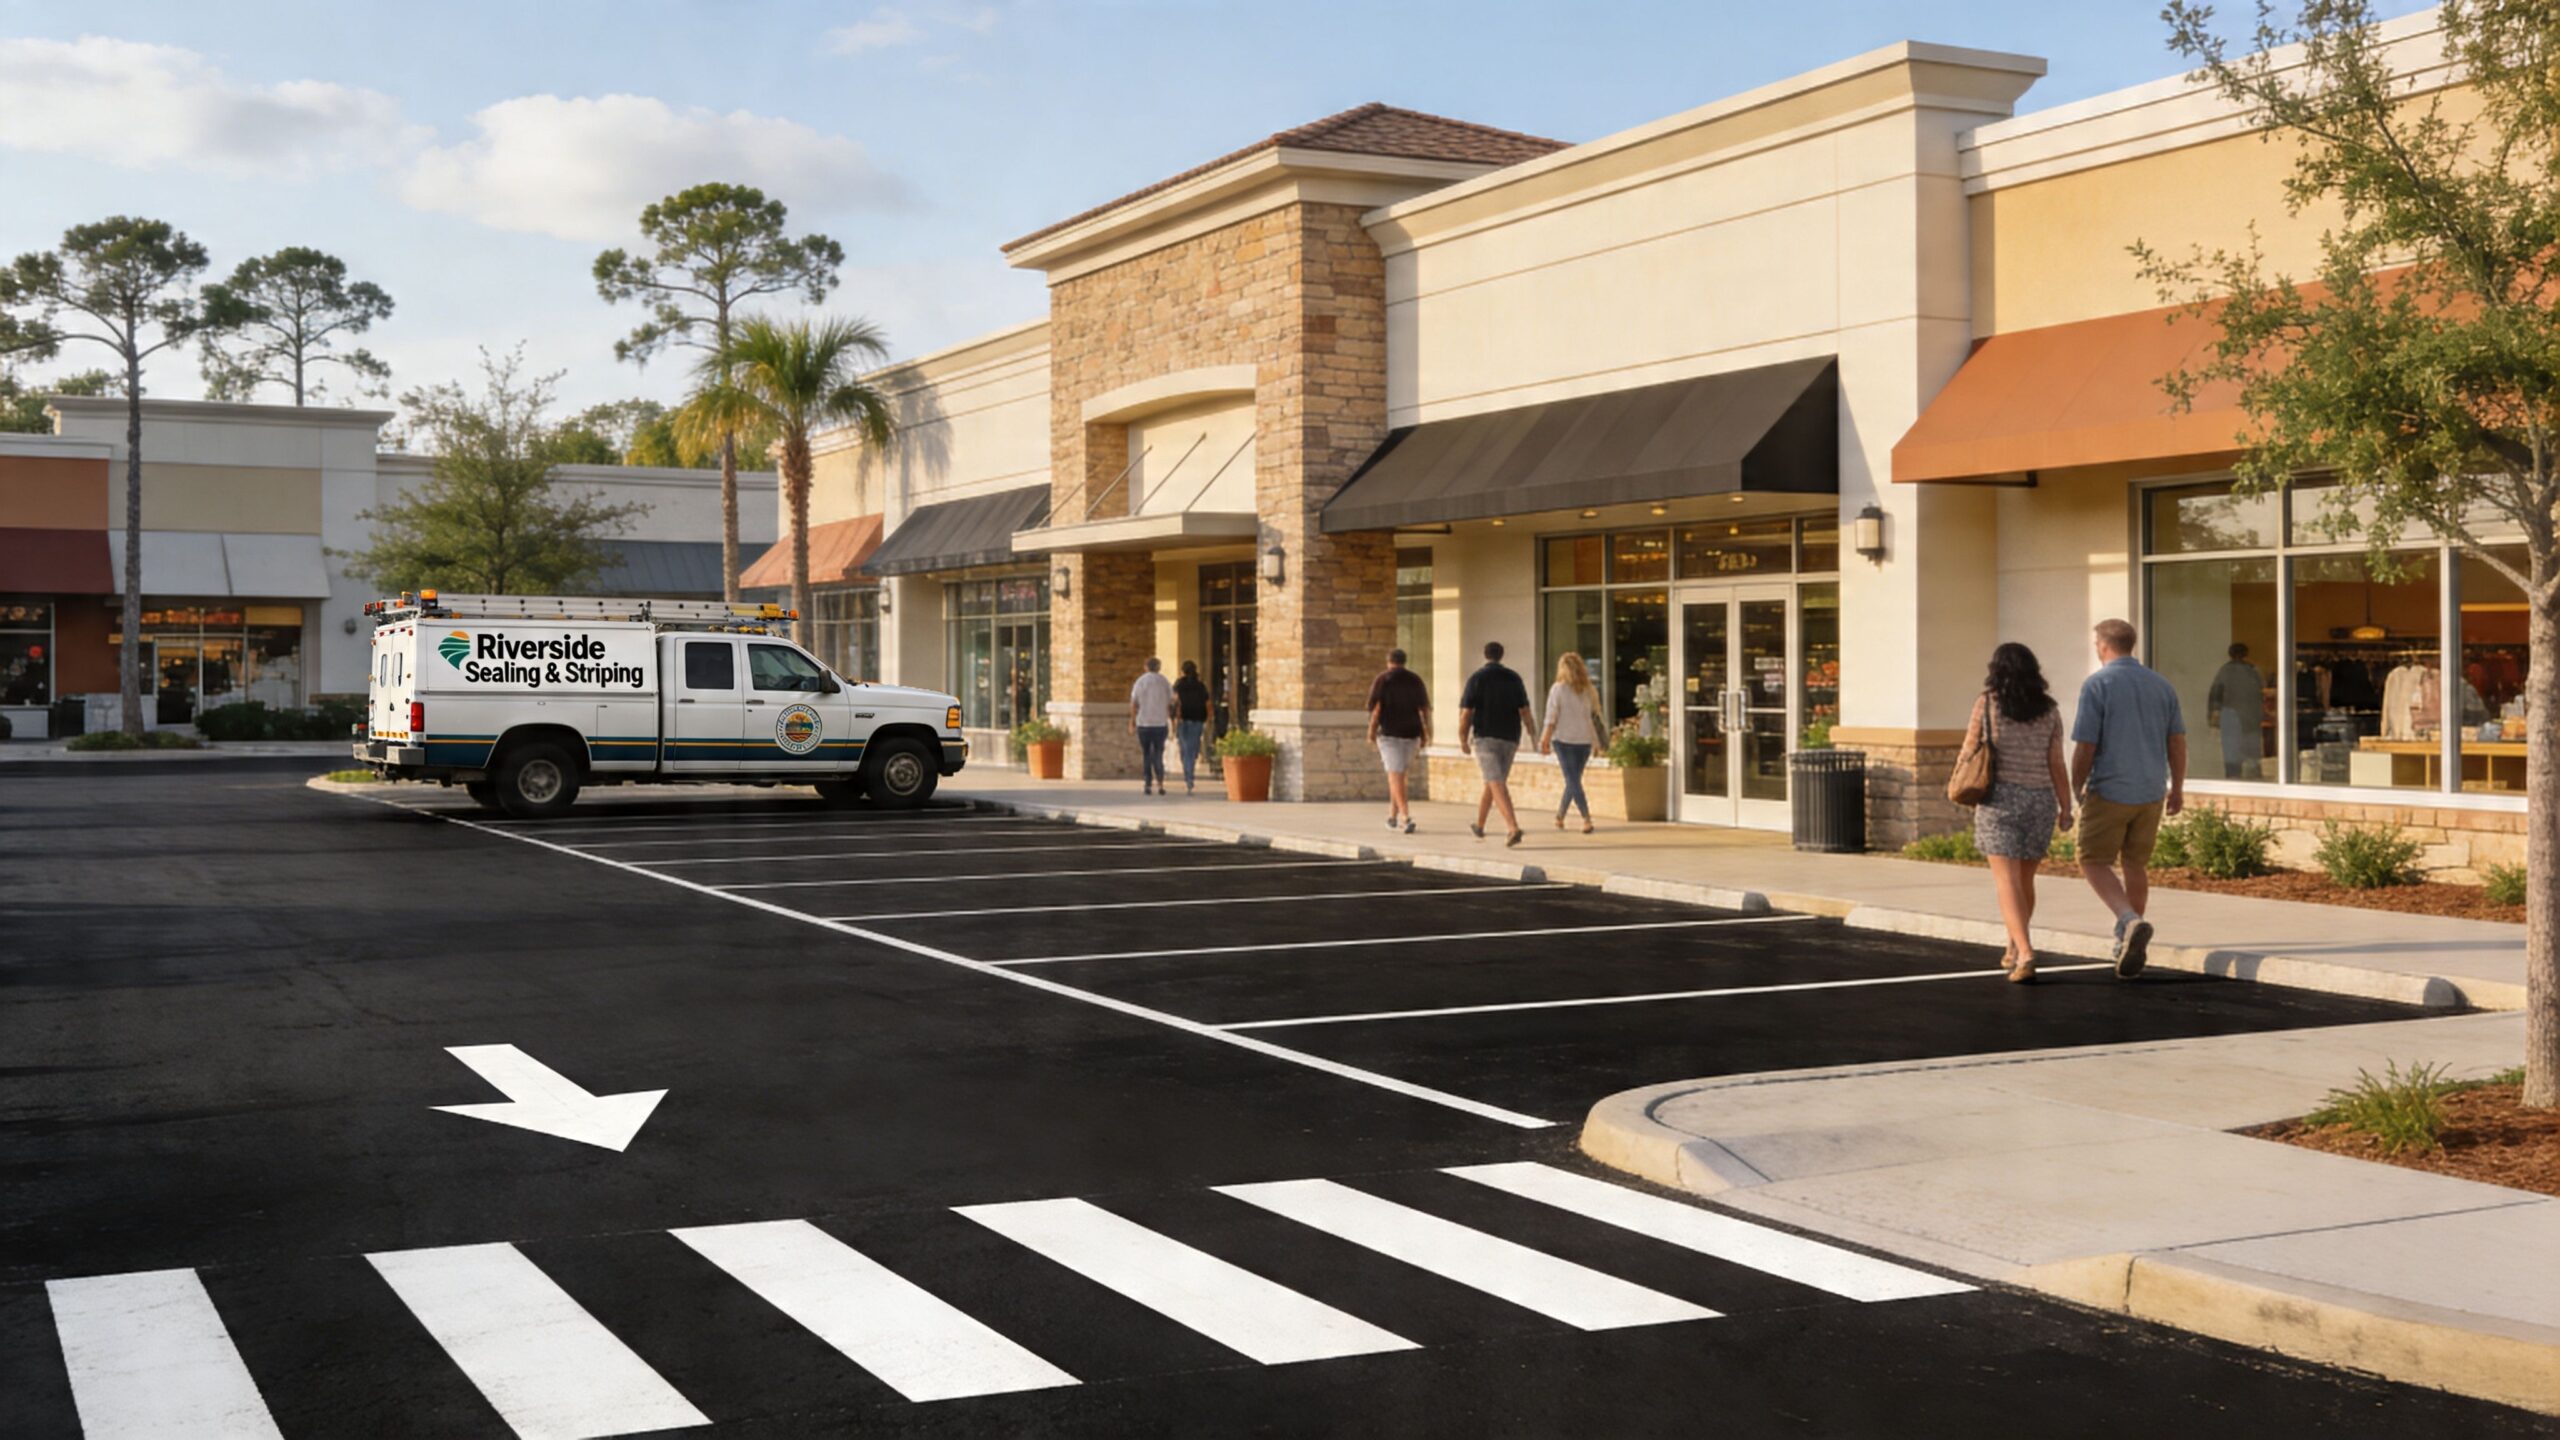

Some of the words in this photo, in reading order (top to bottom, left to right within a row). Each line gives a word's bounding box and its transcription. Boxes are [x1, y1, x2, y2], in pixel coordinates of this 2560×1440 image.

[477, 633, 606, 660] Riverside
[465, 661, 541, 689] Sealing
[545, 662, 562, 684] &
[565, 662, 644, 689] Striping
